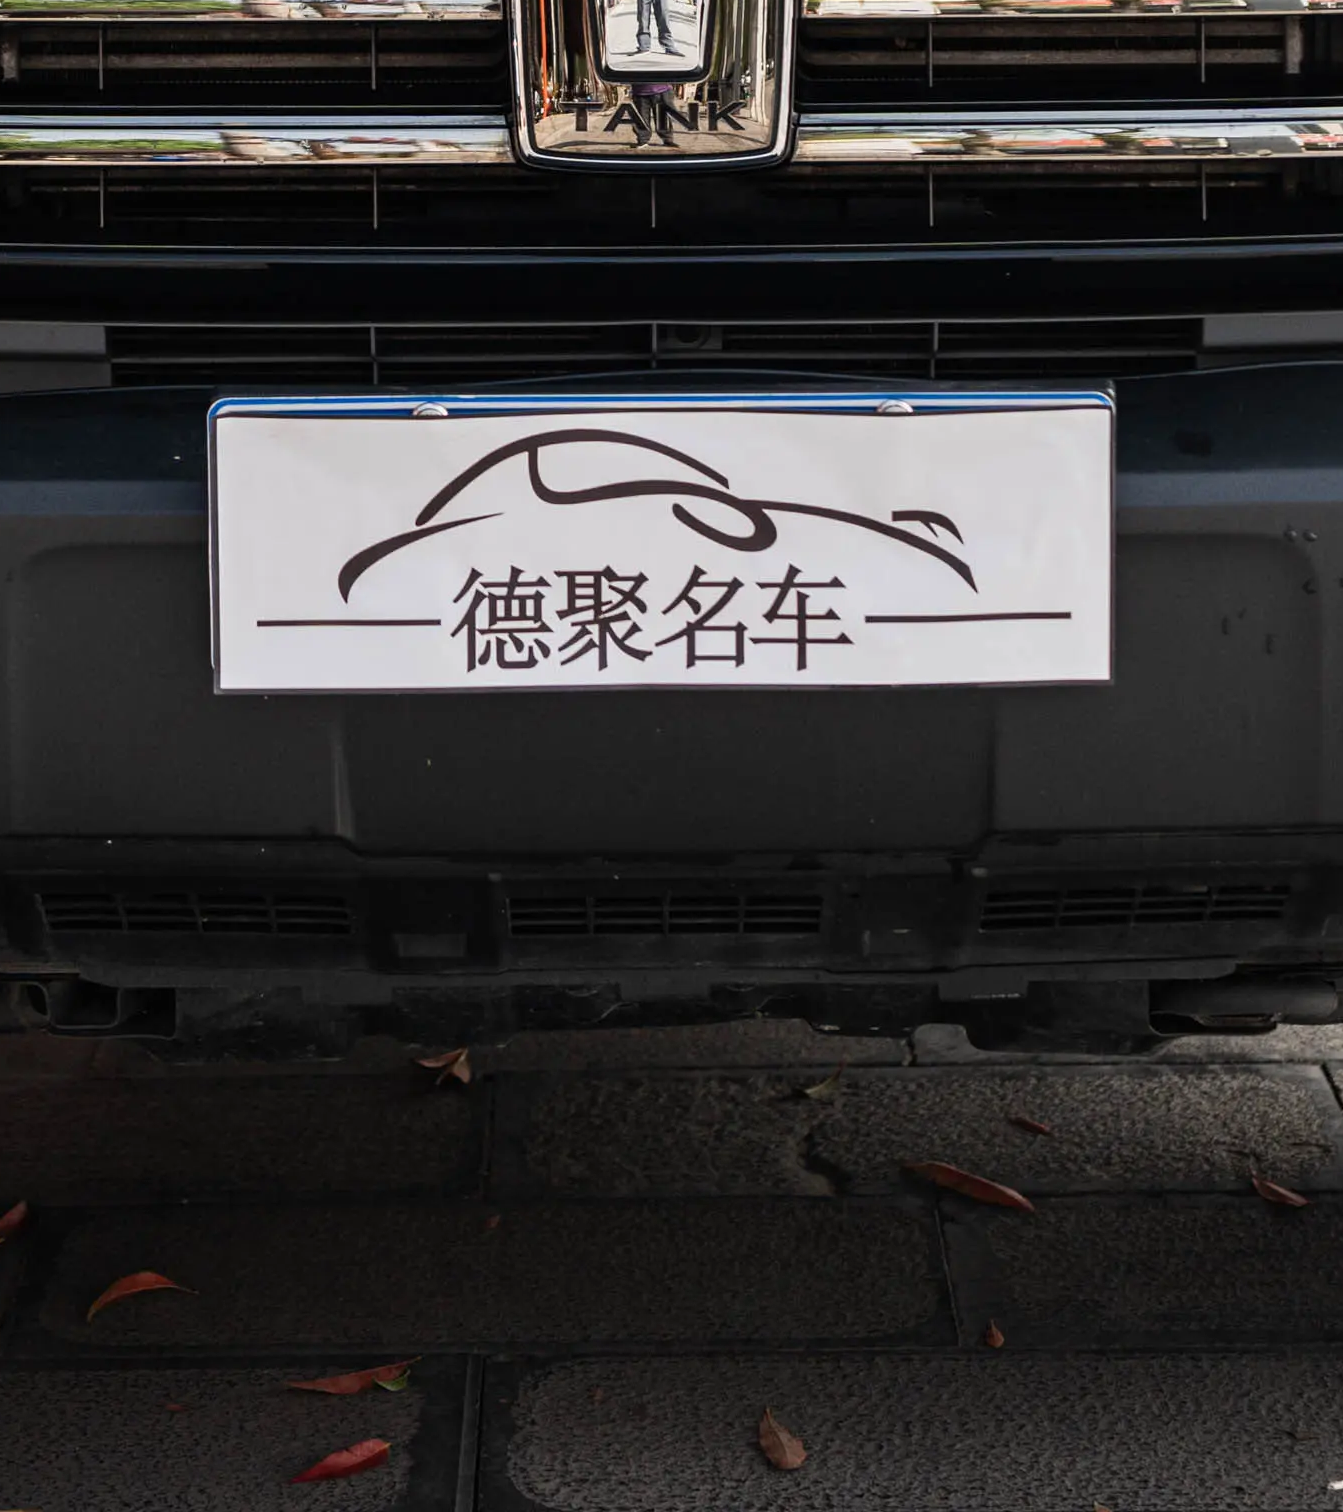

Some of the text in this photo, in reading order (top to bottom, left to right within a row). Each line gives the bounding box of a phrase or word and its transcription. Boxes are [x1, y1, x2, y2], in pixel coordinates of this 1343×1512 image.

[559, 100, 747, 133] TANK
[450, 563, 855, 673] 德聚名车
